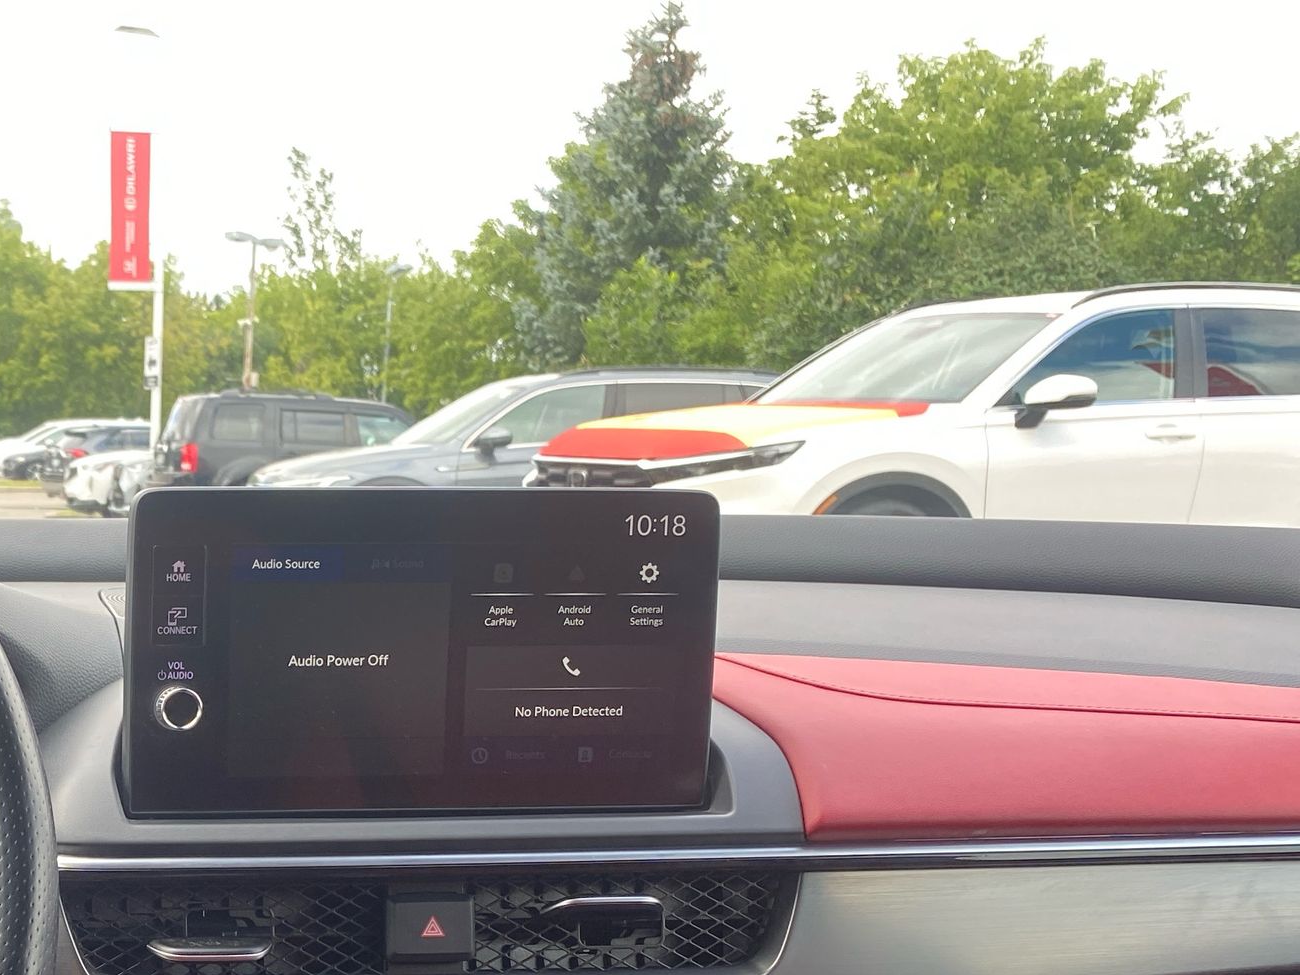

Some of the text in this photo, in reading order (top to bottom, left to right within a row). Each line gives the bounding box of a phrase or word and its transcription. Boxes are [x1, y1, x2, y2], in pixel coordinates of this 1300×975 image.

[126, 137, 136, 196] DILAWRI
[625, 514, 686, 536] 10:18
[252, 558, 321, 570] Audio Source
[166, 573, 191, 582] HOME
[489, 606, 514, 616] Apple
[558, 605, 591, 615] Android
[631, 605, 663, 615] General
[484, 617, 517, 628] CarPlay
[563, 617, 584, 626] Auto
[630, 616, 663, 628] Settings
[157, 626, 197, 635] CONNECT
[288, 654, 389, 667] Audio Power Off
[168, 662, 185, 670] VOL
[168, 671, 193, 680] AUDIO
[515, 706, 623, 717] No Phone Detected
